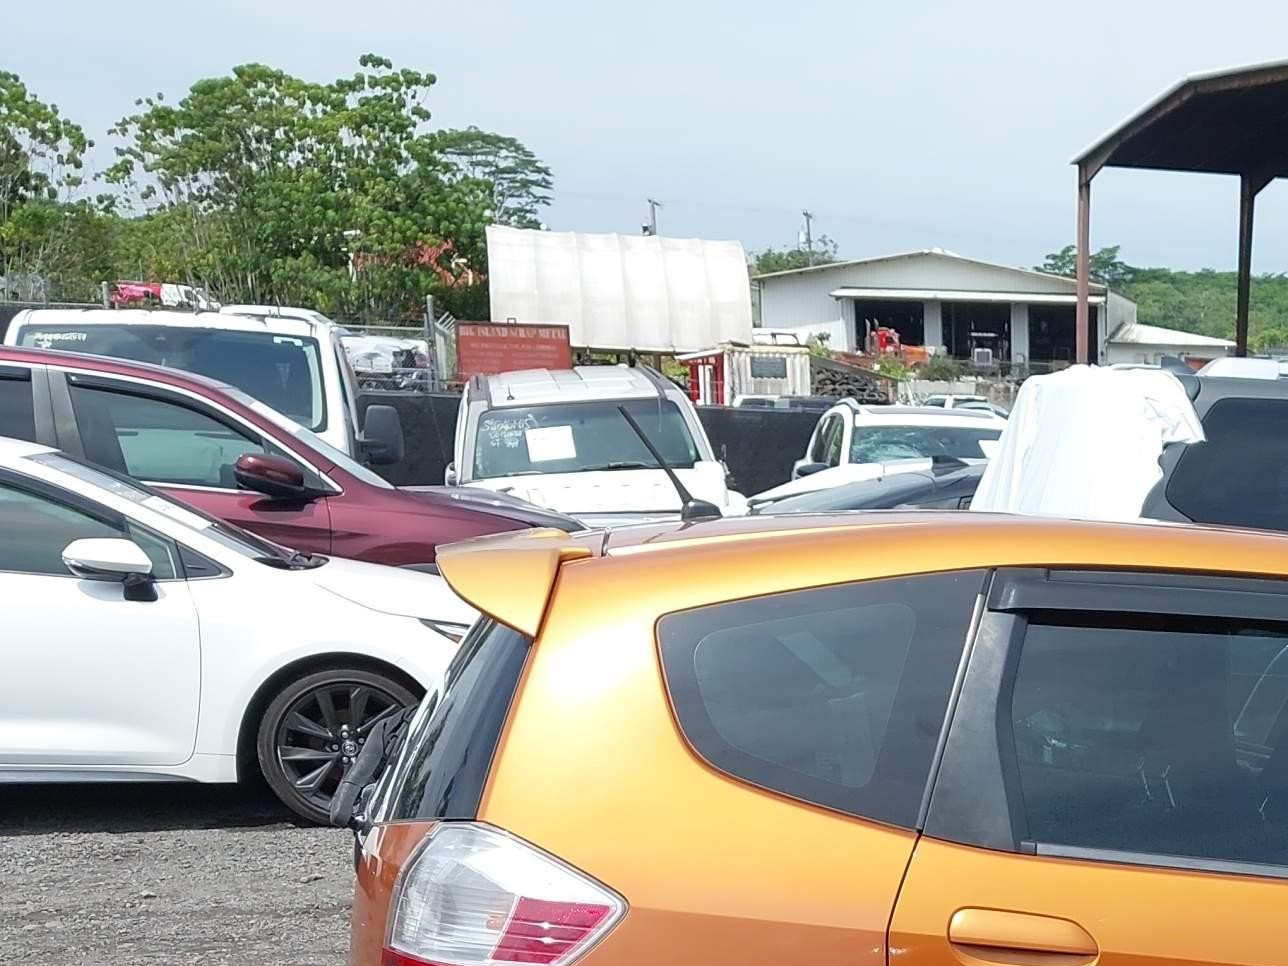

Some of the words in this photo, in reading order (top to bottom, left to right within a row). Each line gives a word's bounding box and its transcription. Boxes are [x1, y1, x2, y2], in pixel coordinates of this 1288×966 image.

[459, 325, 475, 336] BIG
[478, 326, 508, 337] ISLAND
[510, 327, 536, 339] SCRAP
[538, 328, 567, 340] METAL
